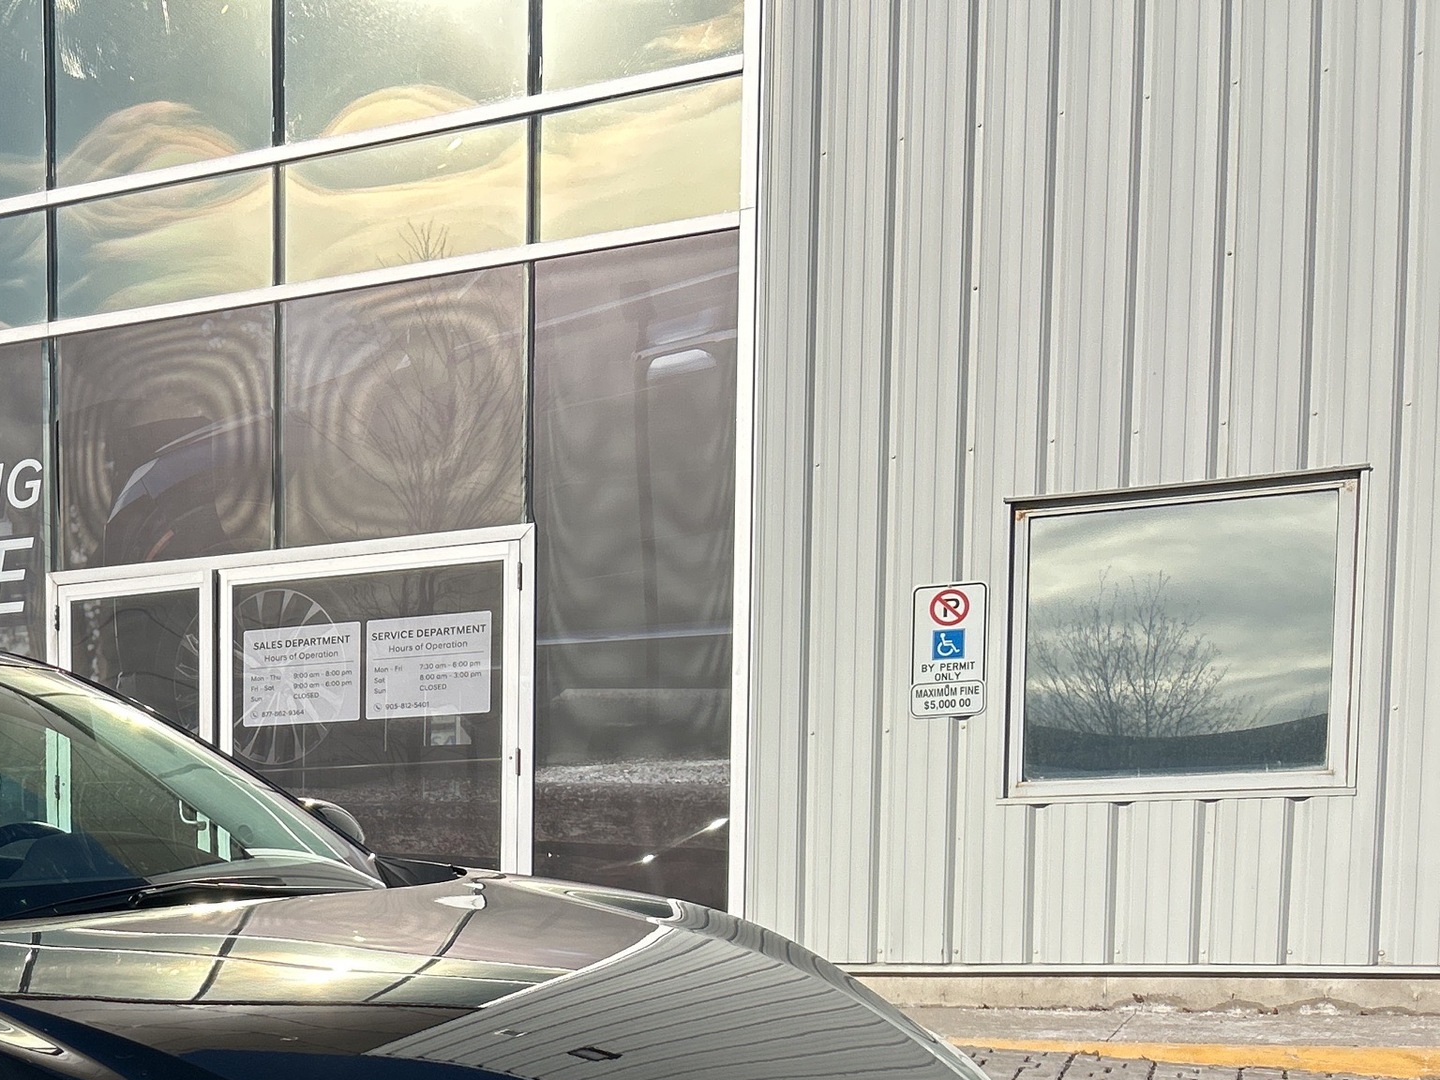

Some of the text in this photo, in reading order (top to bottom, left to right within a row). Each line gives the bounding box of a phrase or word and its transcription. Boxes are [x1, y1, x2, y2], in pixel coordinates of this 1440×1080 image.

[372, 624, 486, 641] SERVICE DEPARTMENT
[253, 635, 350, 650] SALES DEPARTMENT
[388, 644, 413, 653] Hours
[426, 640, 468, 651] Operation
[264, 654, 287, 662] Hours
[299, 650, 338, 660] Operation
[921, 661, 976, 673] BY PERMIT
[934, 672, 961, 681] ONLY
[341, 680, 352, 688] pm
[293, 692, 320, 700] CLOSED
[915, 685, 980, 698] MAXIMUM FINE
